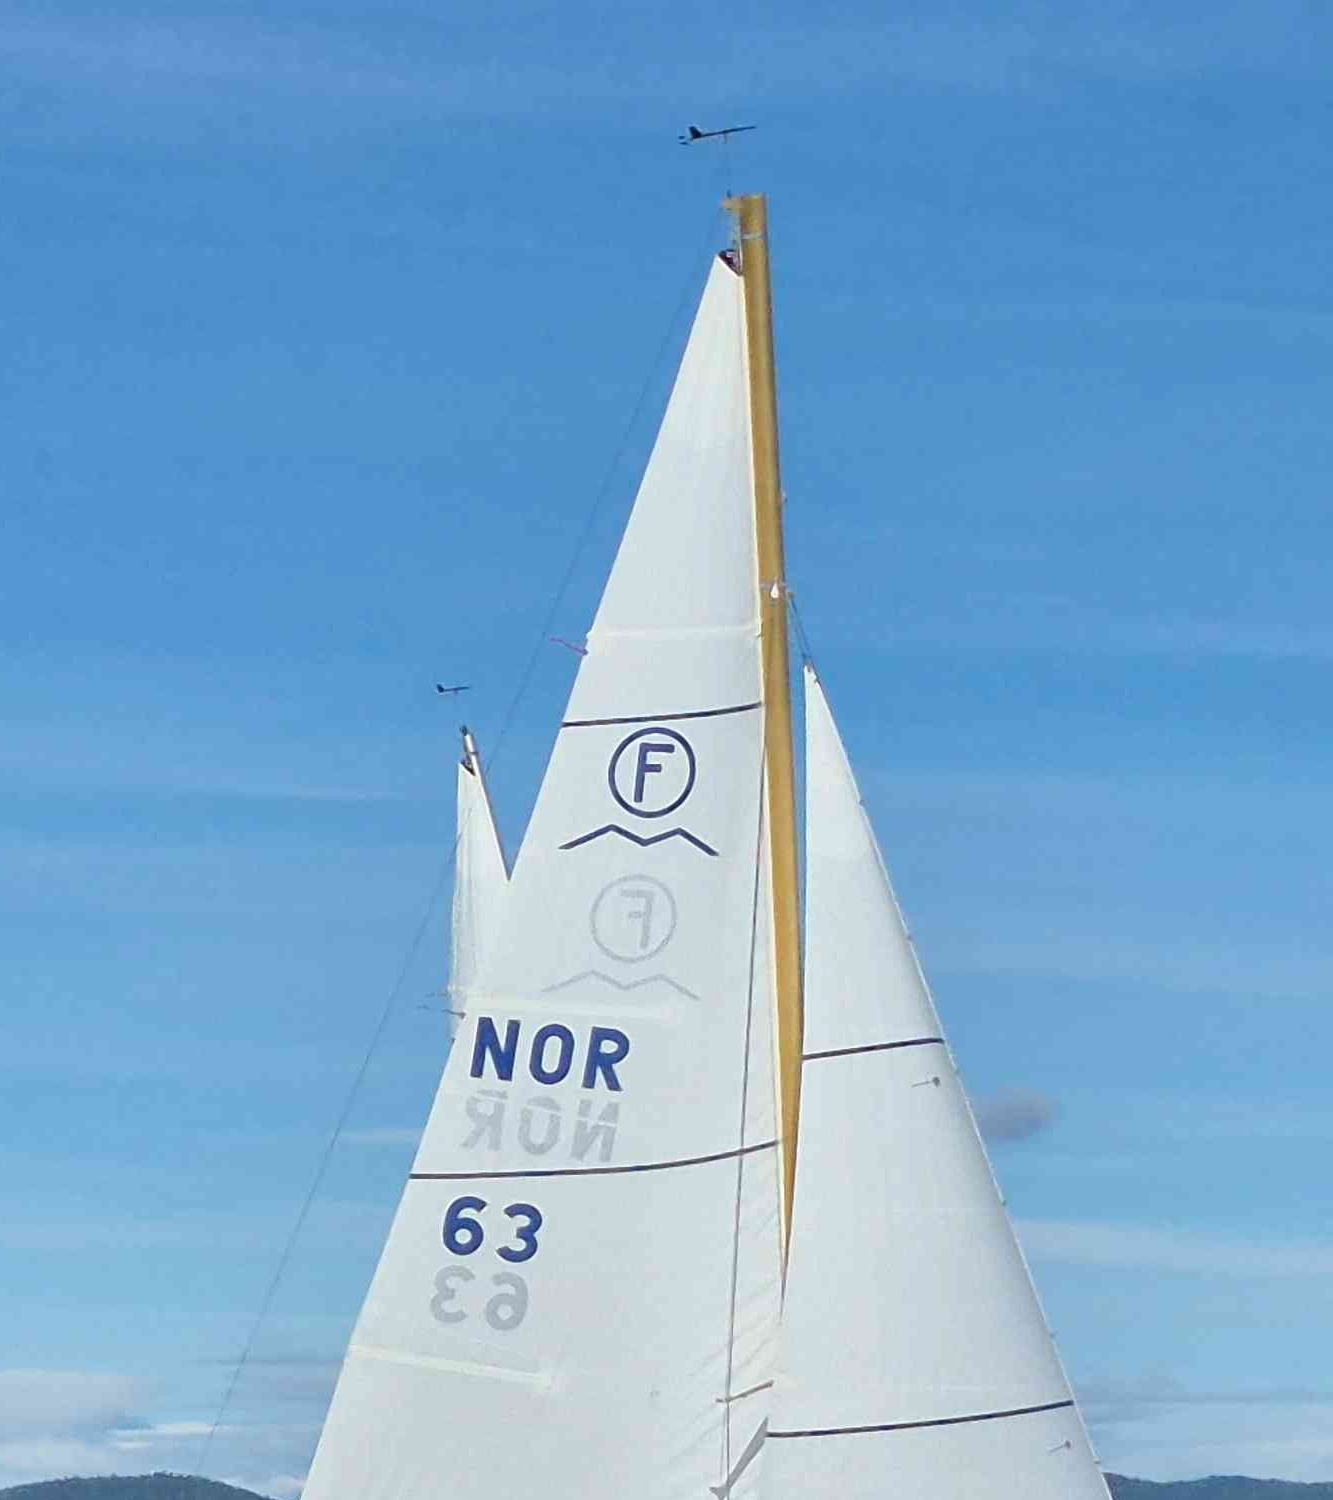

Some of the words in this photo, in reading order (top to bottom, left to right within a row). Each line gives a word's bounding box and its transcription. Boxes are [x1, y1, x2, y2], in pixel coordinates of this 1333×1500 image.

[634, 742, 675, 803] F
[469, 1016, 630, 1092] NOR
[442, 1196, 543, 1263] 63
